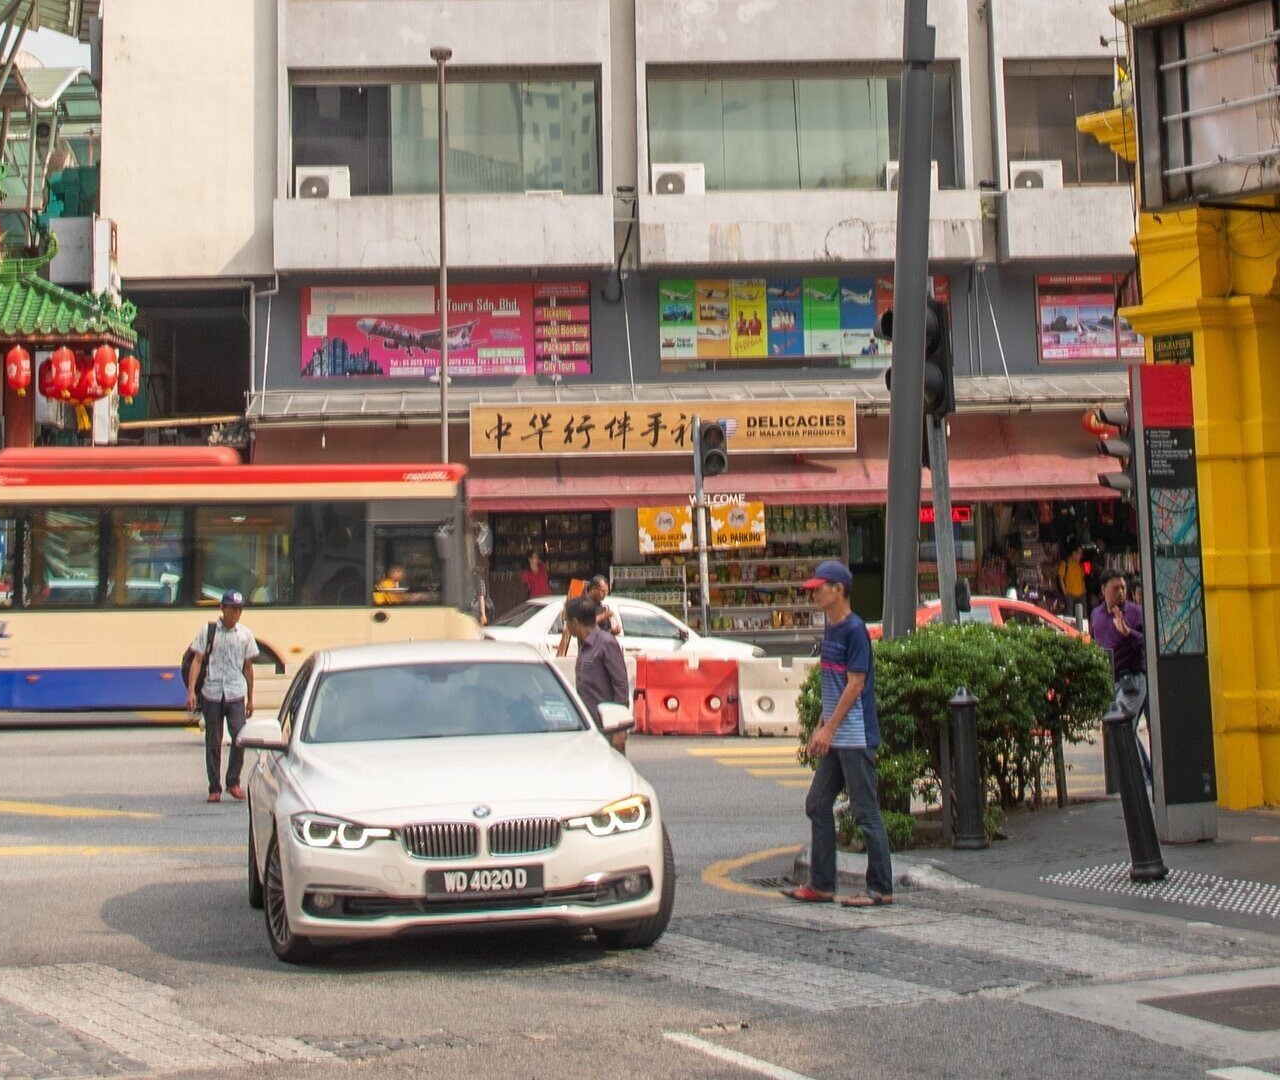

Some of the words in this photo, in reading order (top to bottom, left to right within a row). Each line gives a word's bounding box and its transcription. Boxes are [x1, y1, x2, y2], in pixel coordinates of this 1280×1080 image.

[499, 298, 520, 312] Bhd.
[543, 308, 572, 319] Ticketing
[560, 325, 588, 337] Booking
[543, 342, 571, 354] Package
[543, 361, 556, 372] City
[557, 361, 576, 371] Tours
[746, 414, 846, 428] DELICACIES
[759, 429, 800, 438] MALAYSIA
[802, 428, 846, 437] PRODUCTS
[688, 493, 746, 505] WELCOME
[717, 534, 727, 543] NO
[730, 532, 761, 543] PARKING
[443, 871, 468, 893] WD
[470, 869, 513, 891] 4020
[514, 868, 527, 889] D
